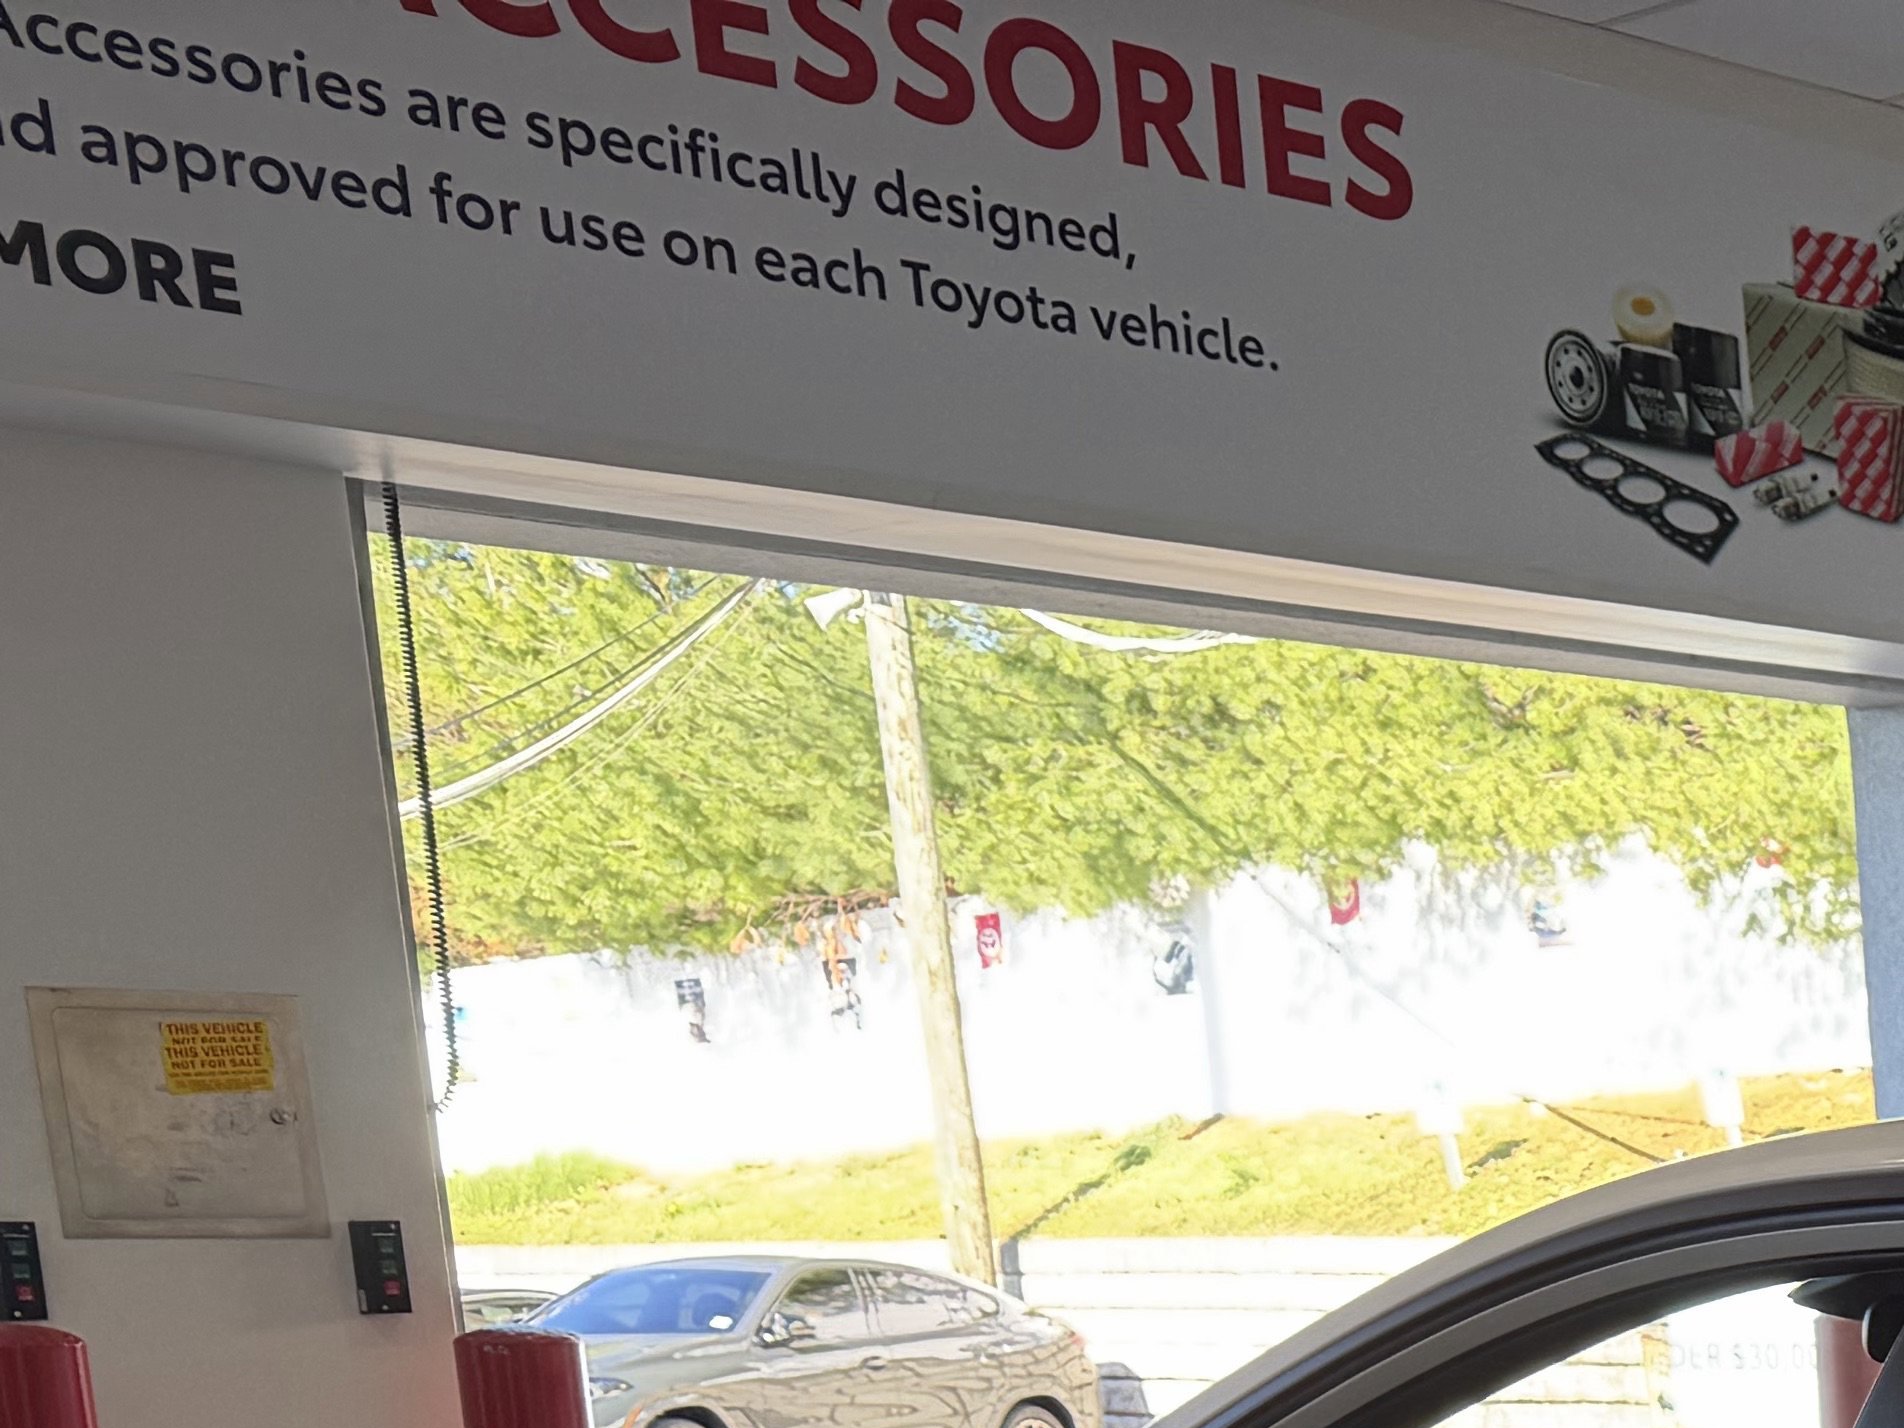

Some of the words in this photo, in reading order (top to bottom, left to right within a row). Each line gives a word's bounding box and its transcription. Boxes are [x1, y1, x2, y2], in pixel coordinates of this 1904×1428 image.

[400, 0, 1413, 220] ESSORIES
[408, 89, 506, 140] are
[526, 112, 857, 218] specifically
[874, 168, 1135, 270] designed,
[0, 98, 56, 156] d
[81, 125, 412, 218] approved
[429, 172, 520, 235] for
[540, 207, 645, 257] use
[663, 230, 737, 275] on
[755, 247, 887, 301] each
[900, 259, 1077, 335] Toyota
[1090, 303, 1279, 371] vehicle.
[0, 220, 242, 315] MORE
[165, 1046, 198, 1059] THIS
[201, 1043, 264, 1057] VEHICLE
[166, 1022, 199, 1036] THIS
[202, 1021, 264, 1035] VEHICLE
[171, 1060, 196, 1070] NOT
[201, 1058, 226, 1069] FOR
[230, 1057, 262, 1068] SALE
